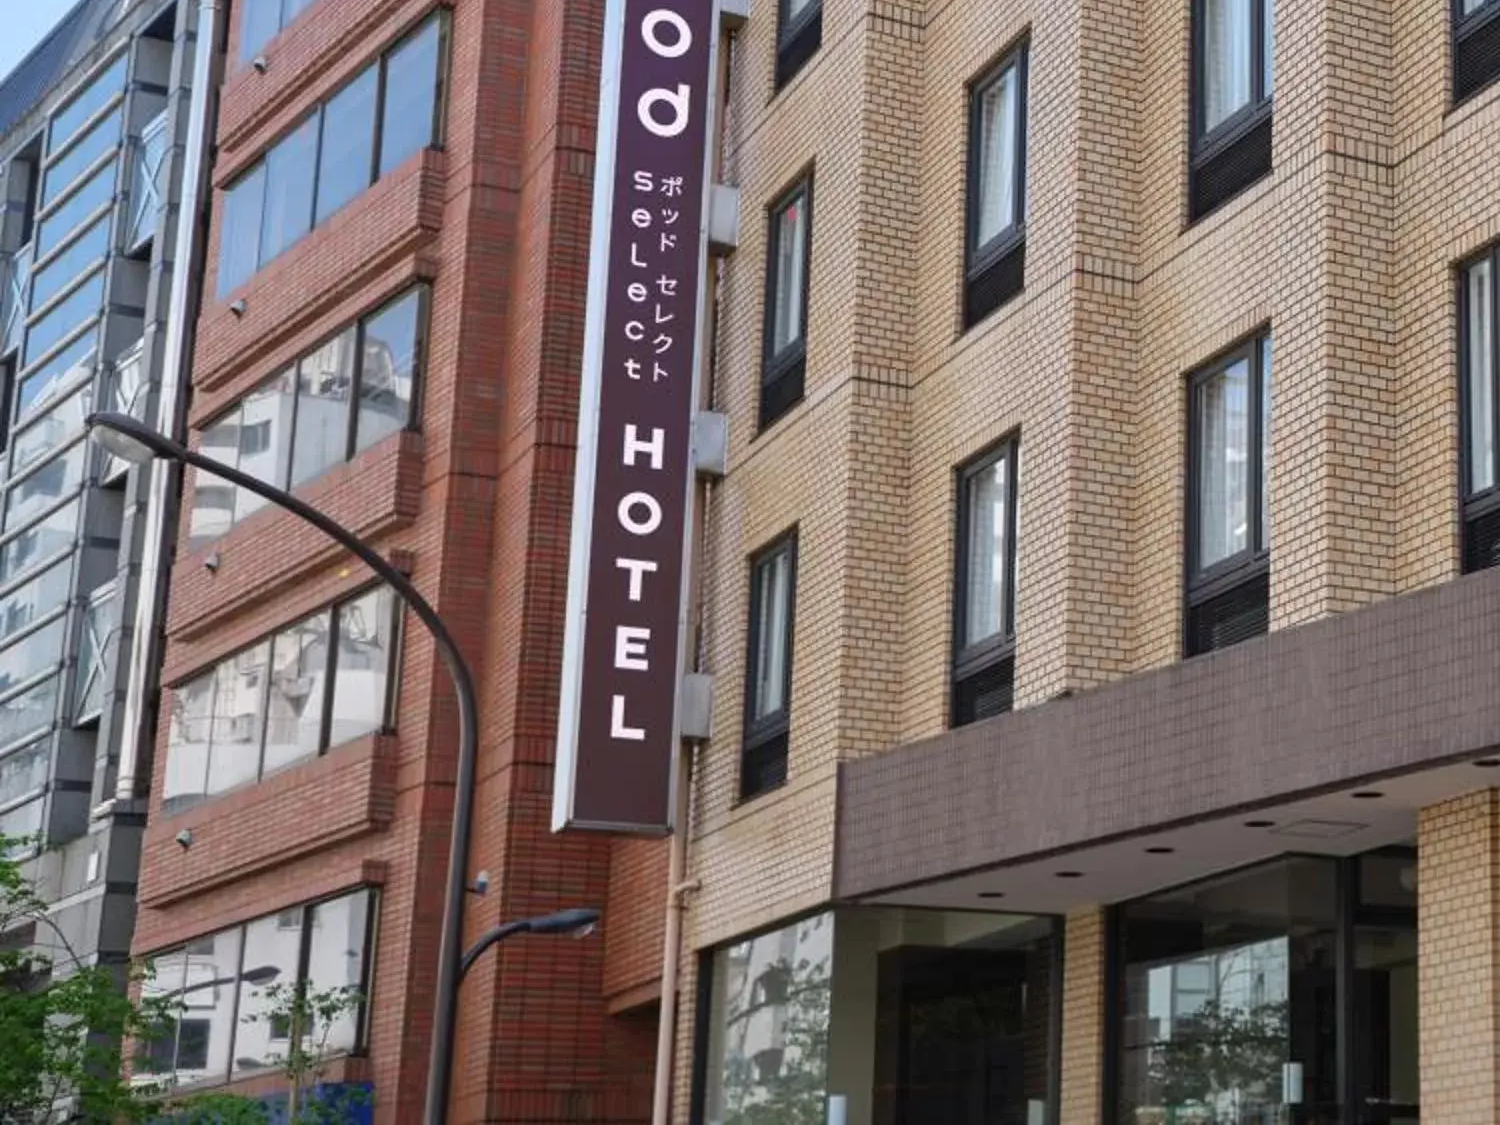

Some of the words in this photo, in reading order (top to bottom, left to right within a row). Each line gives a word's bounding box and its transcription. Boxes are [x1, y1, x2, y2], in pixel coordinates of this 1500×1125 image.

[659, 175, 683, 250] ポッド
[652, 275, 678, 382] セレクト
[610, 424, 665, 741] HOTEL
